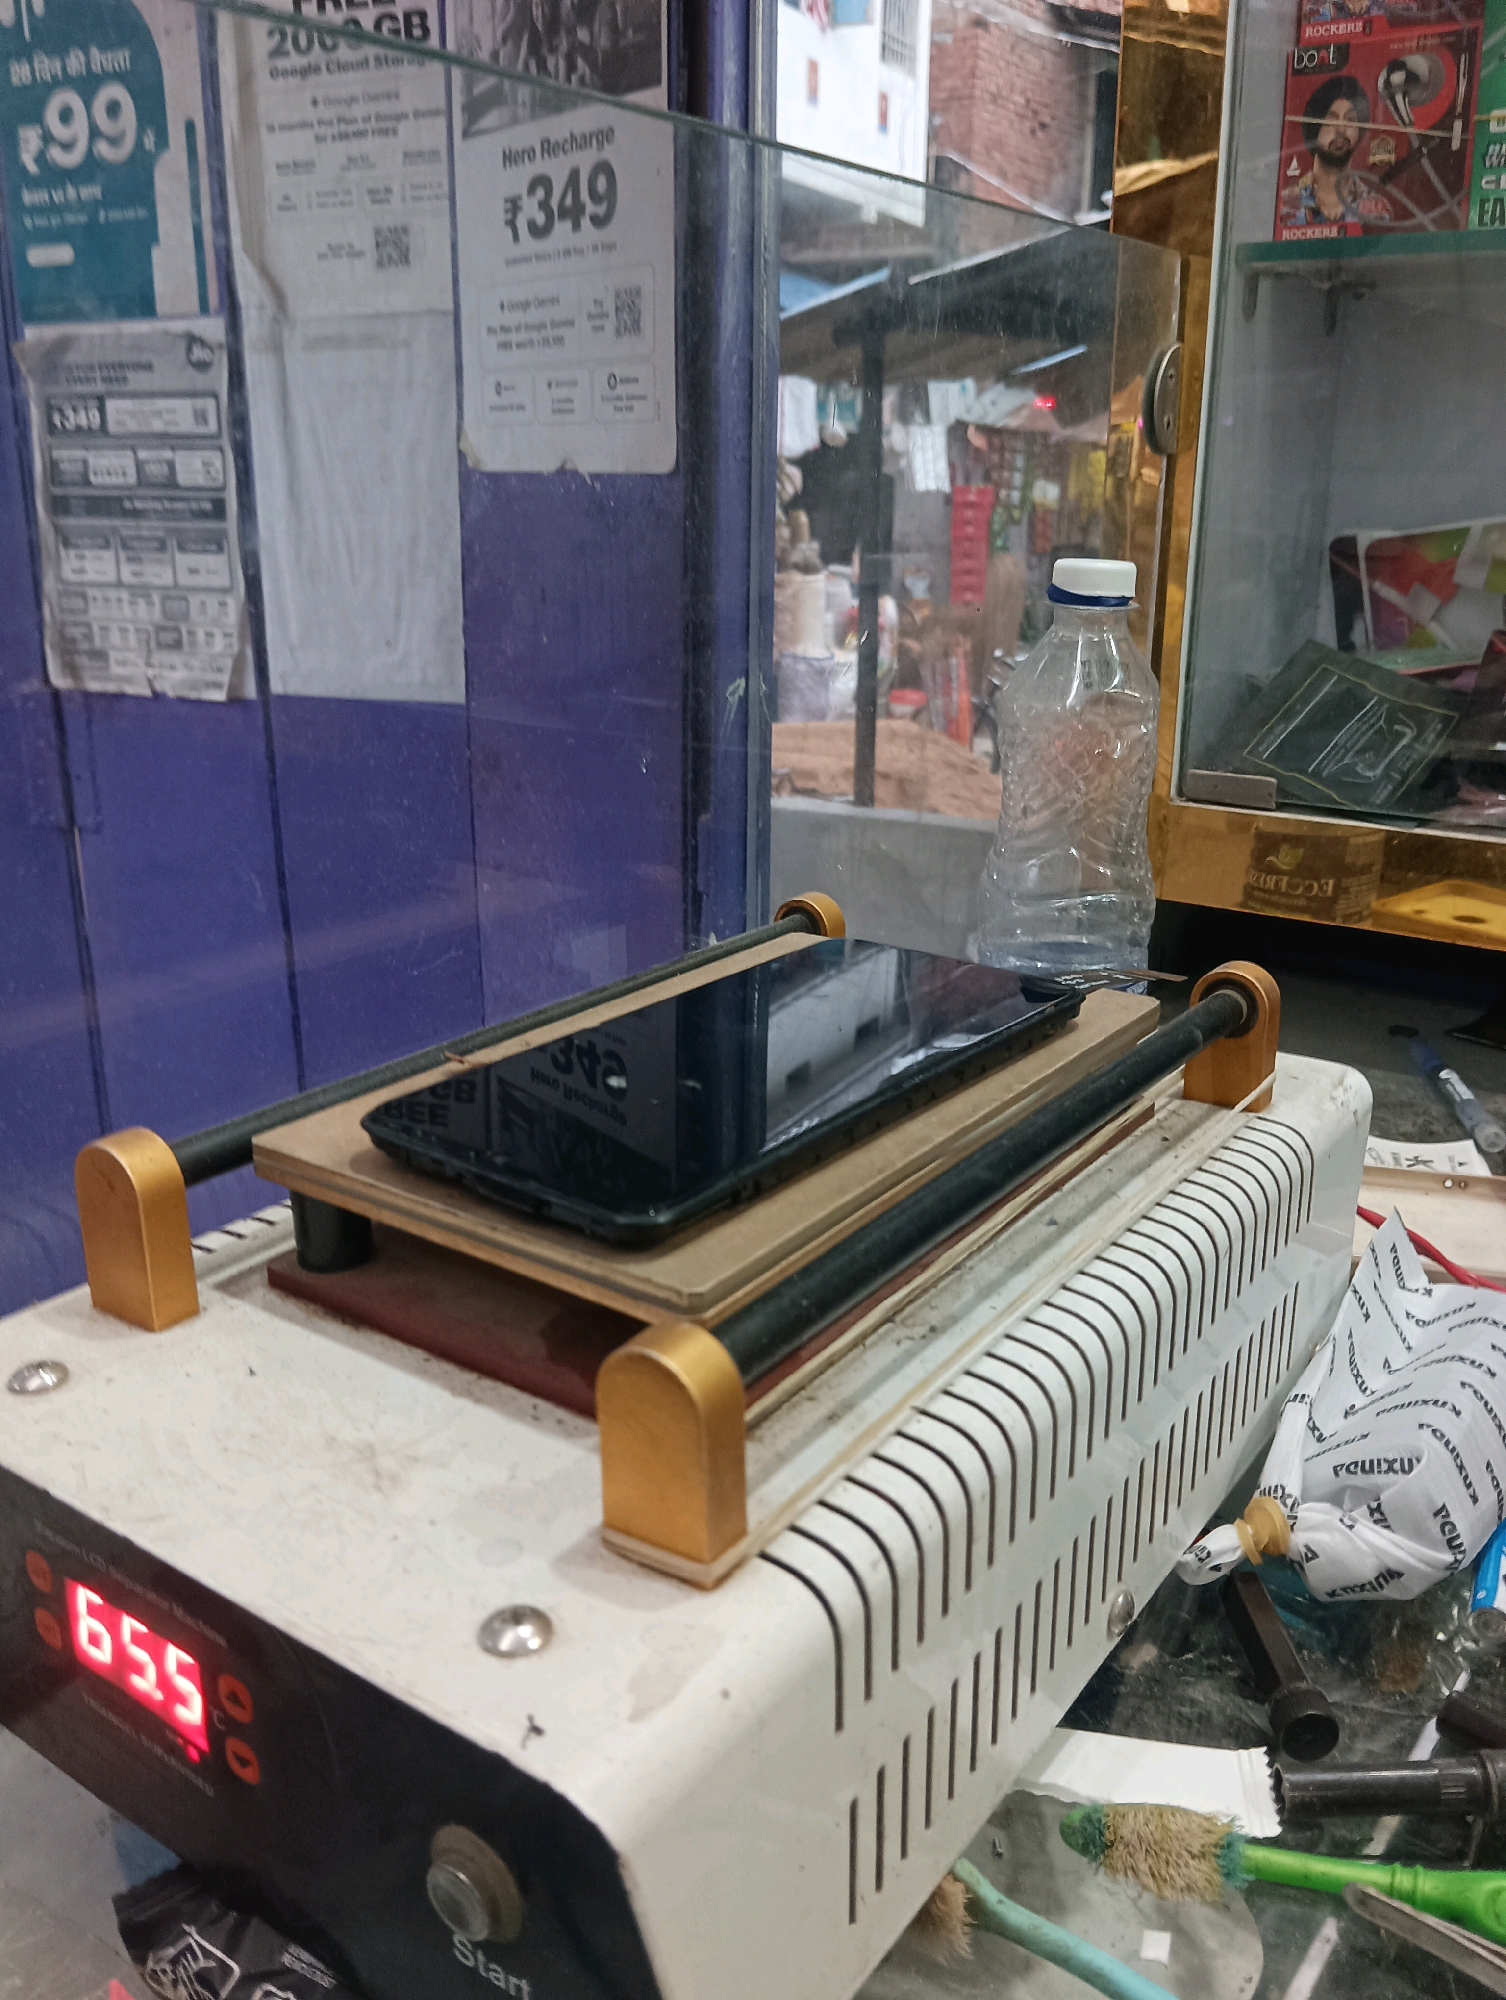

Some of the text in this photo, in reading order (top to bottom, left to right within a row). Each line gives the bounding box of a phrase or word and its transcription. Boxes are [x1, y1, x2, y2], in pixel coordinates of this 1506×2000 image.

[373, 10, 431, 43] GB
[503, 158, 618, 244] ₹349
[452, 1933, 533, 2000] Start
